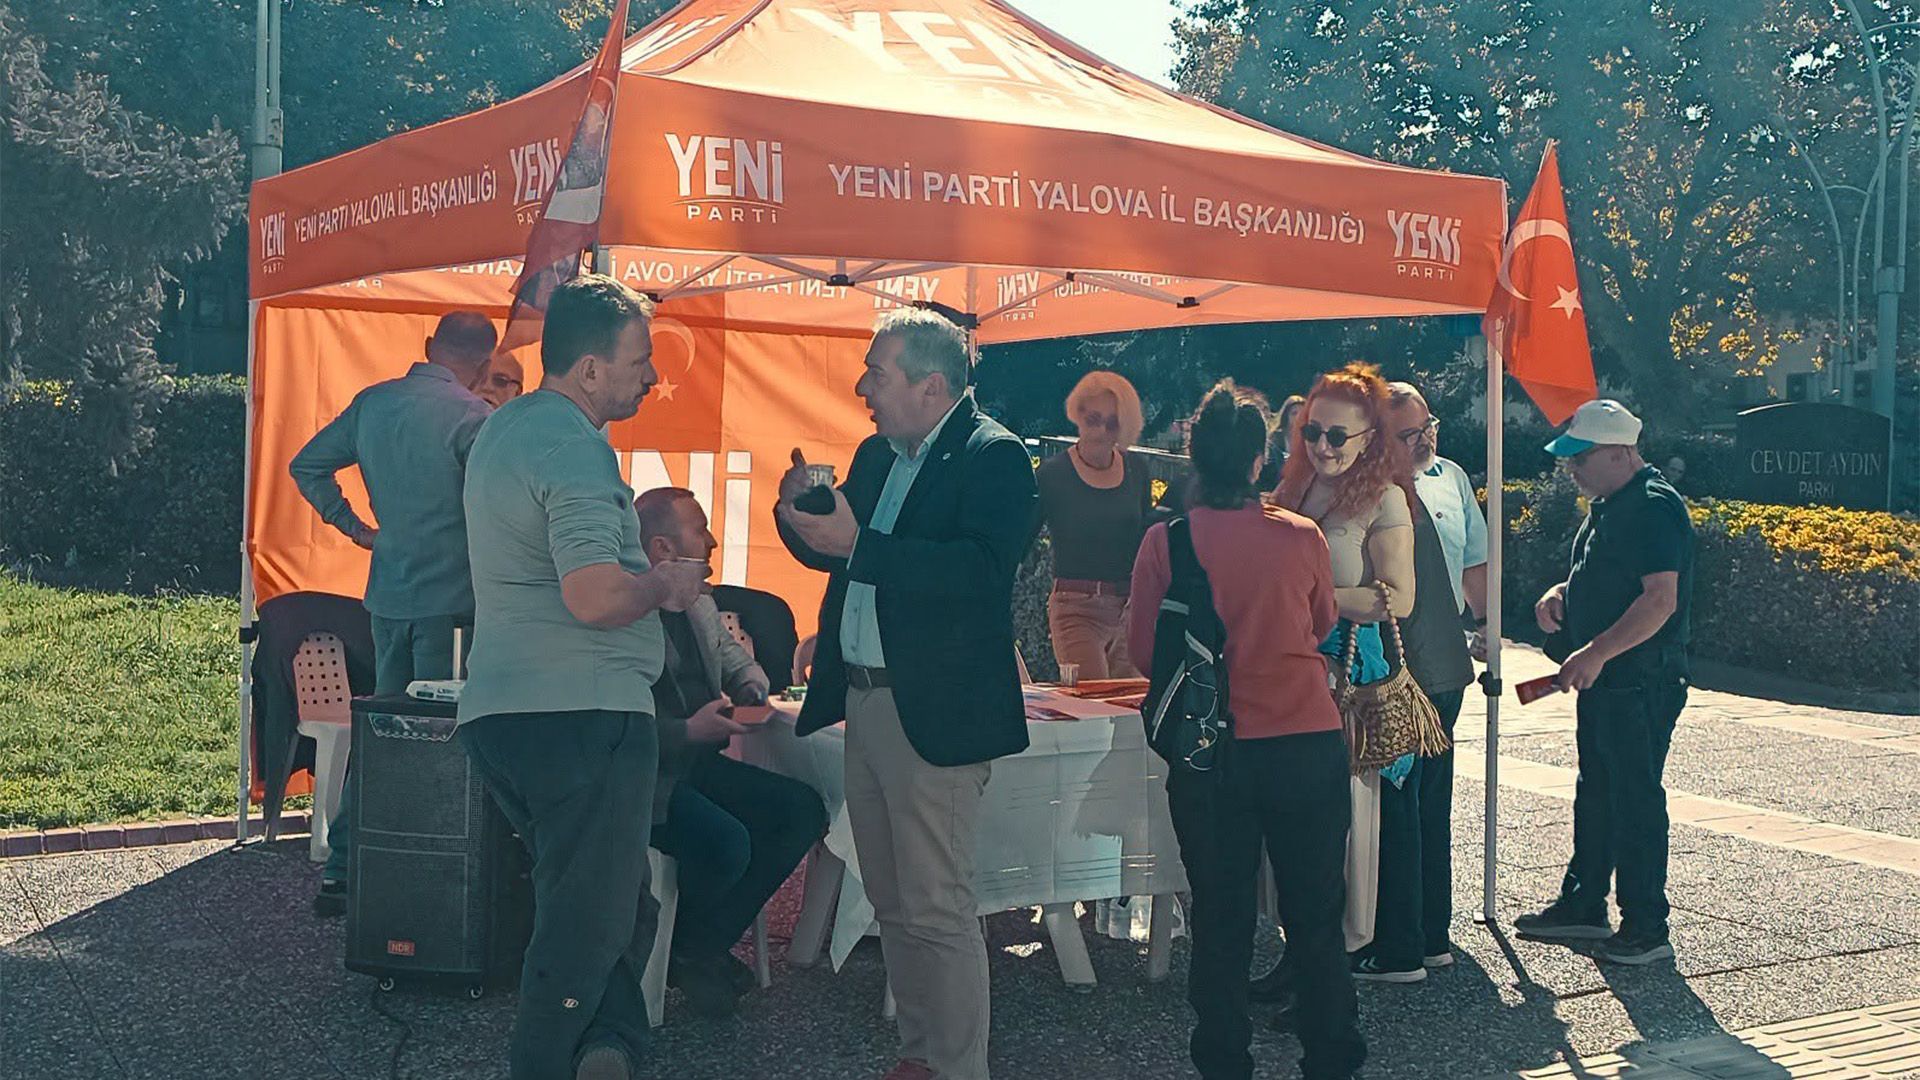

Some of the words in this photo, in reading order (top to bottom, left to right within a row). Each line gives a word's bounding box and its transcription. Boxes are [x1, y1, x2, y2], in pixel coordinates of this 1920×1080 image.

[294, 209, 317, 243] YENİ
[350, 191, 396, 228] YALOVA
[398, 183, 409, 216] İL
[411, 161, 496, 218] BAŞKANLIĞI
[828, 161, 911, 200] YENİ
[923, 170, 1020, 208] PARTİ
[1028, 178, 1153, 219] YALOVA
[1160, 185, 1186, 223] İL
[1194, 197, 1365, 245] BAŞKANLIĞI
[1751, 450, 1822, 475] CEVDET
[1827, 452, 1882, 476] AYDIN
[1799, 481, 1834, 498] PARKI
